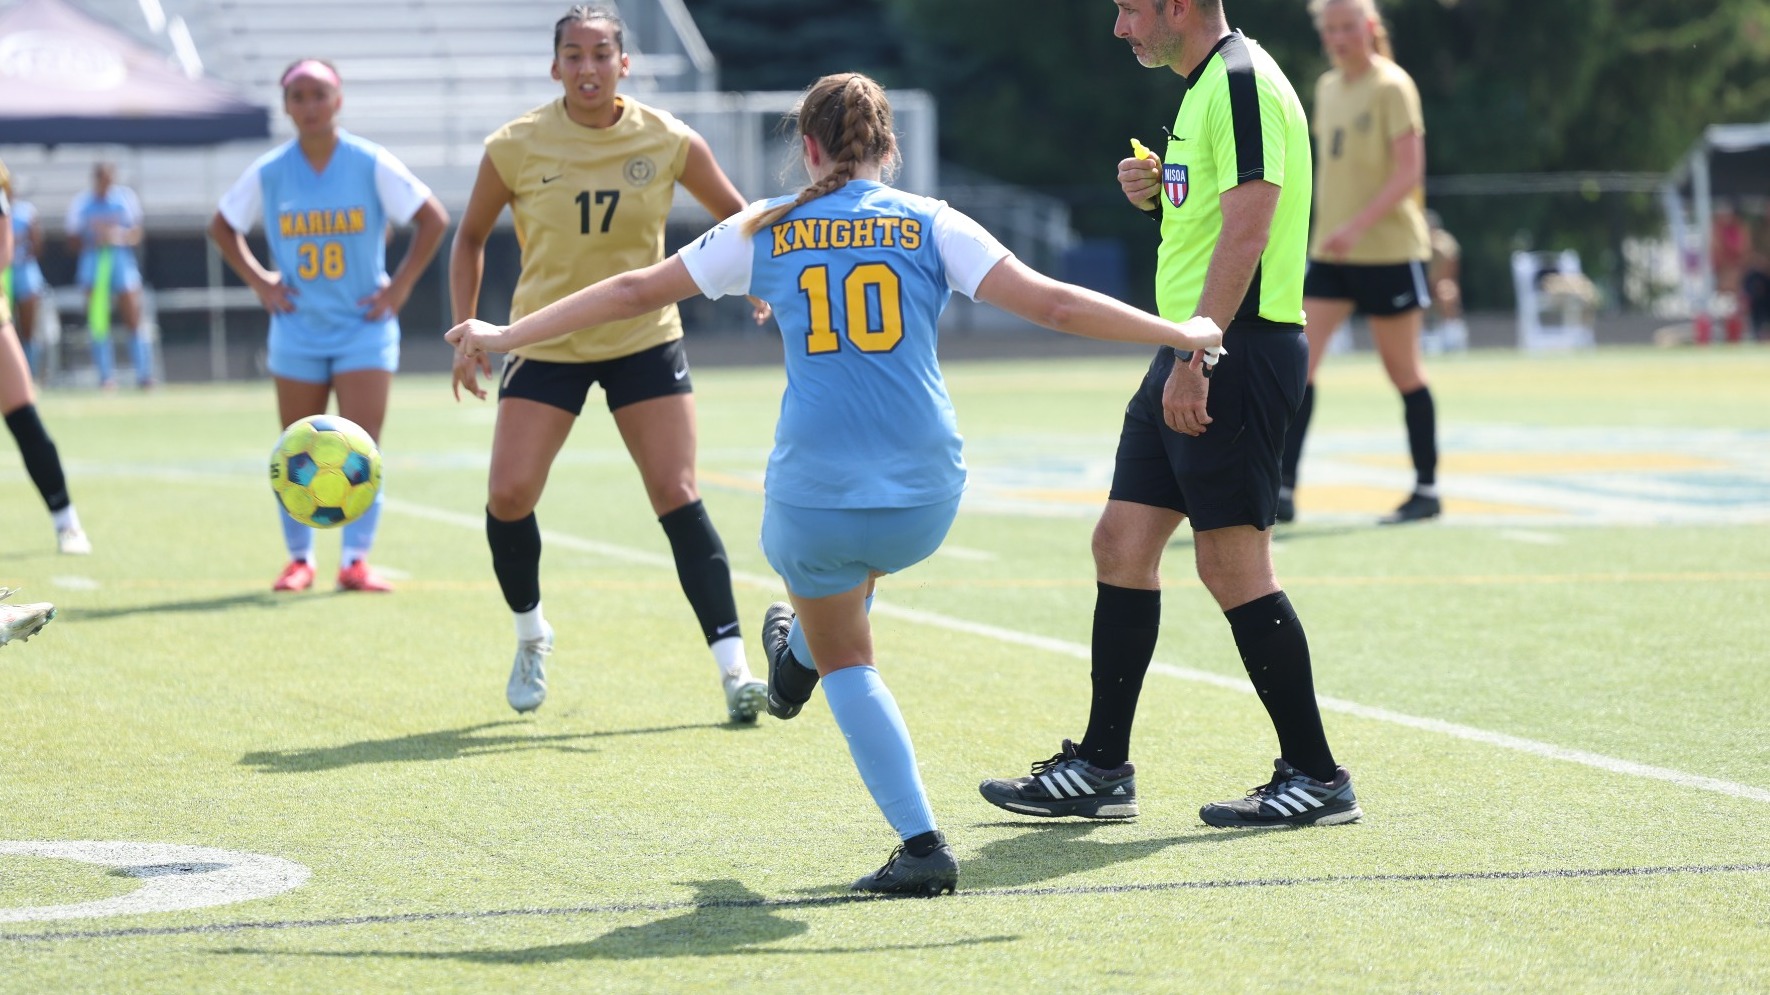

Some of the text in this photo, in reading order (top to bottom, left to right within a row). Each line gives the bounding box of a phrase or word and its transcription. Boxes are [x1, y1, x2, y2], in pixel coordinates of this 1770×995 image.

[1164, 168, 1186, 182] NISOA
[575, 190, 620, 235] 17
[772, 216, 921, 258] KNIGHTS
[298, 242, 345, 280] 38
[798, 261, 905, 356] 10
